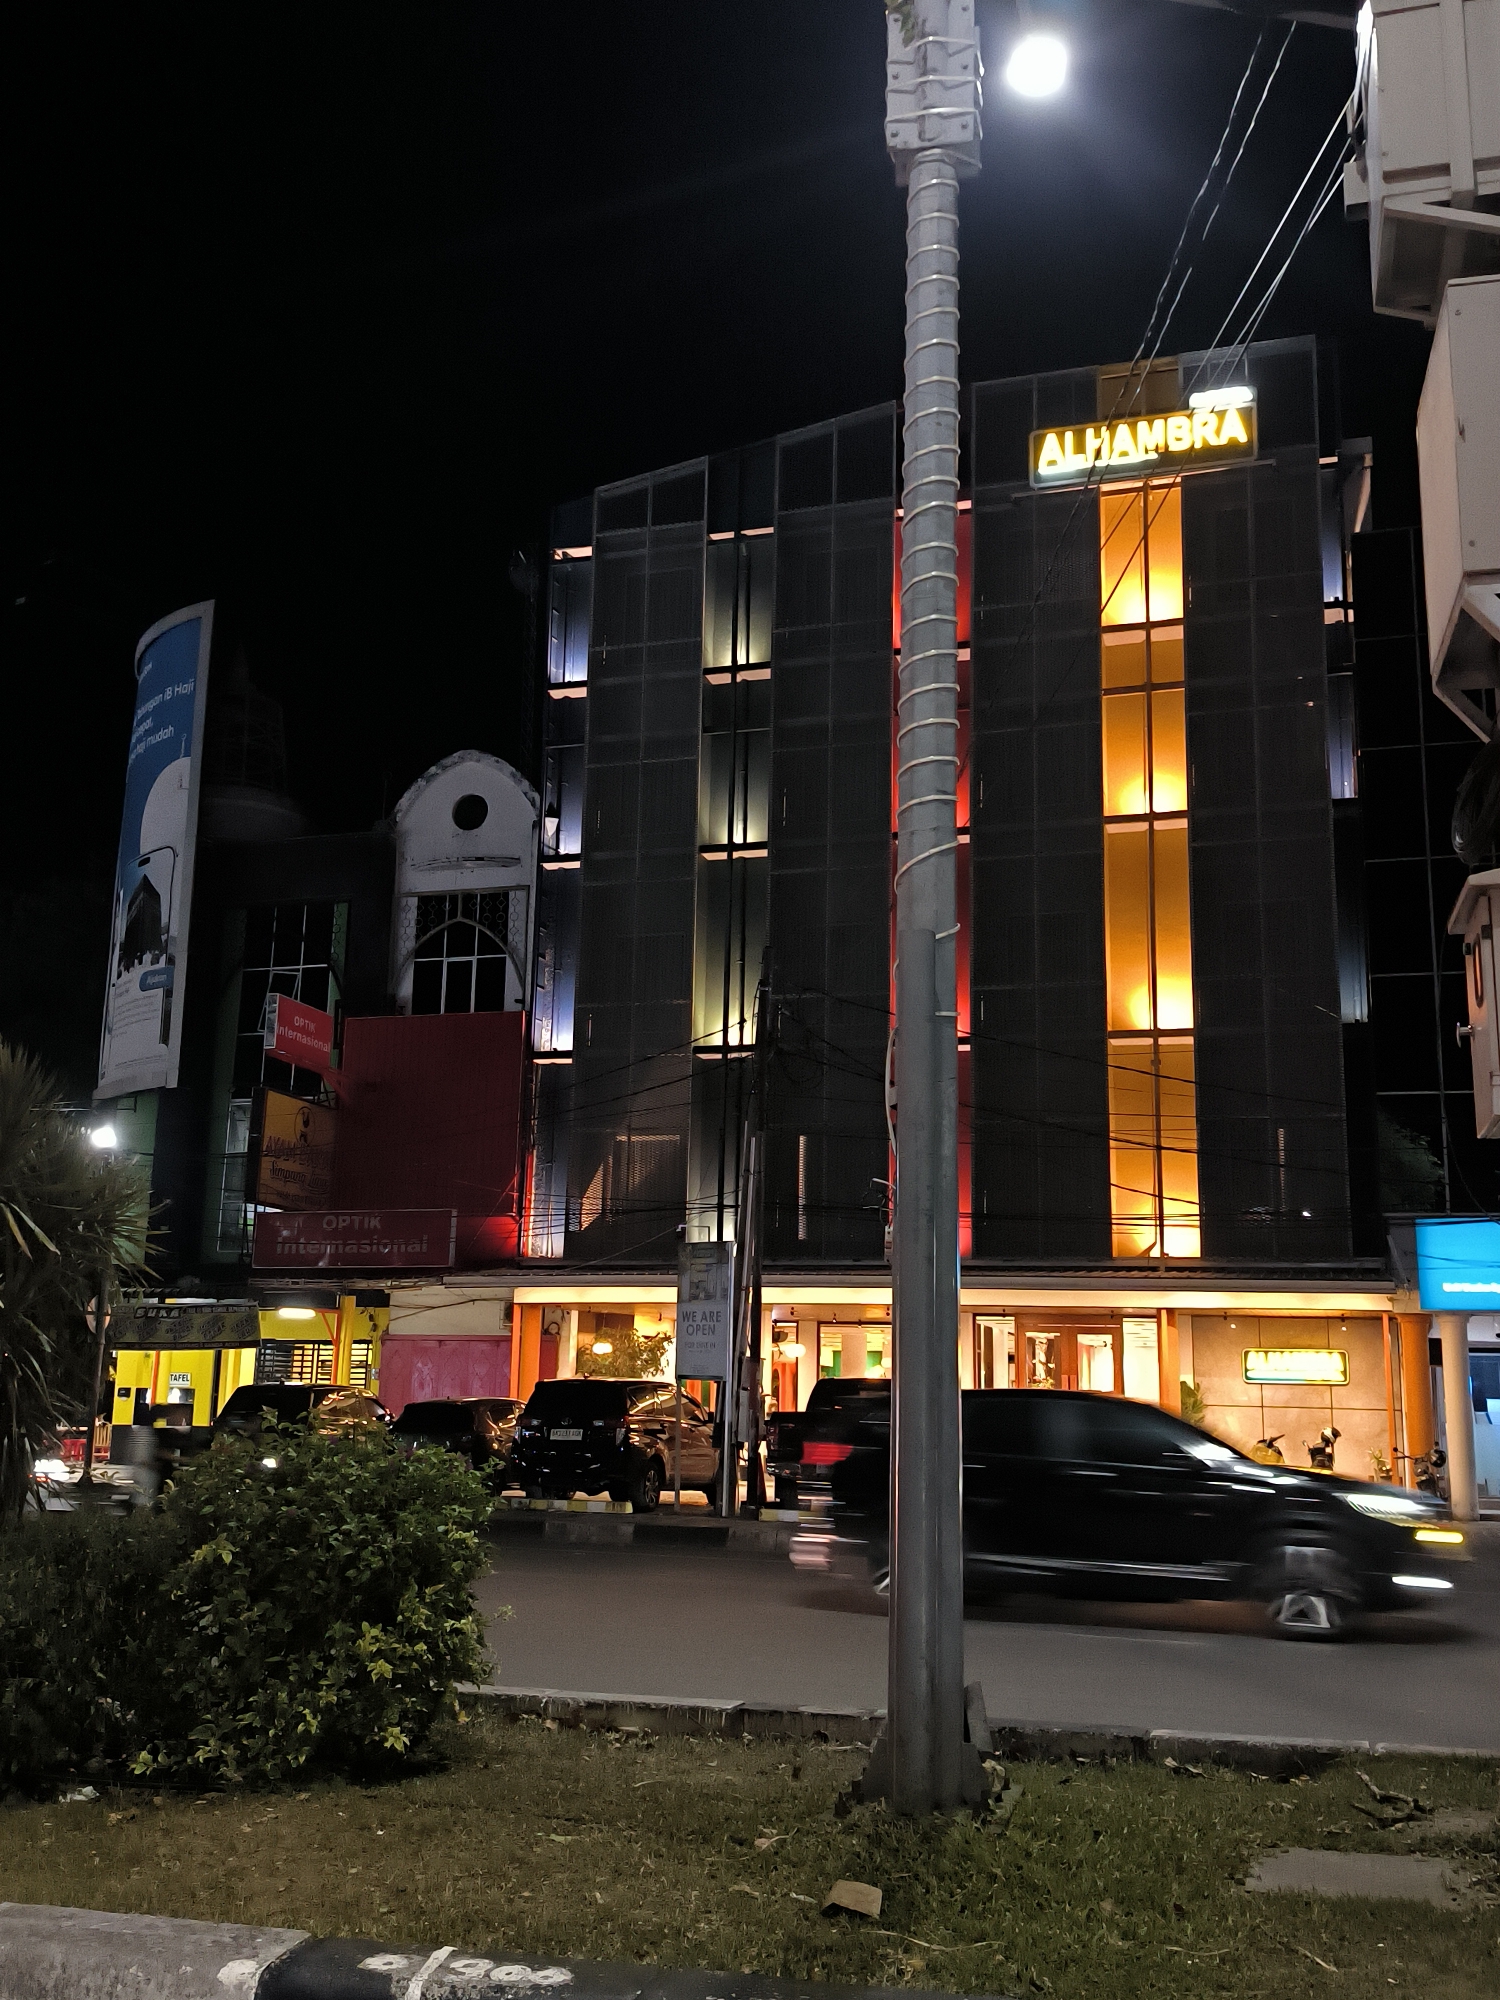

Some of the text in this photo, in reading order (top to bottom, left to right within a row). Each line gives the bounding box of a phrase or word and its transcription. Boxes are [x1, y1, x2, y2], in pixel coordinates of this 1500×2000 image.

[1038, 407, 1248, 474] ALHAMBRA
[174, 678, 196, 697] Haji
[146, 724, 175, 746] mudah
[294, 1016, 316, 1033] OPTIK
[322, 1214, 384, 1230] OPTIK
[682, 1311, 722, 1323] WE ARE
[686, 1324, 716, 1336] OPEN
[170, 1373, 190, 1382] TAFEL
